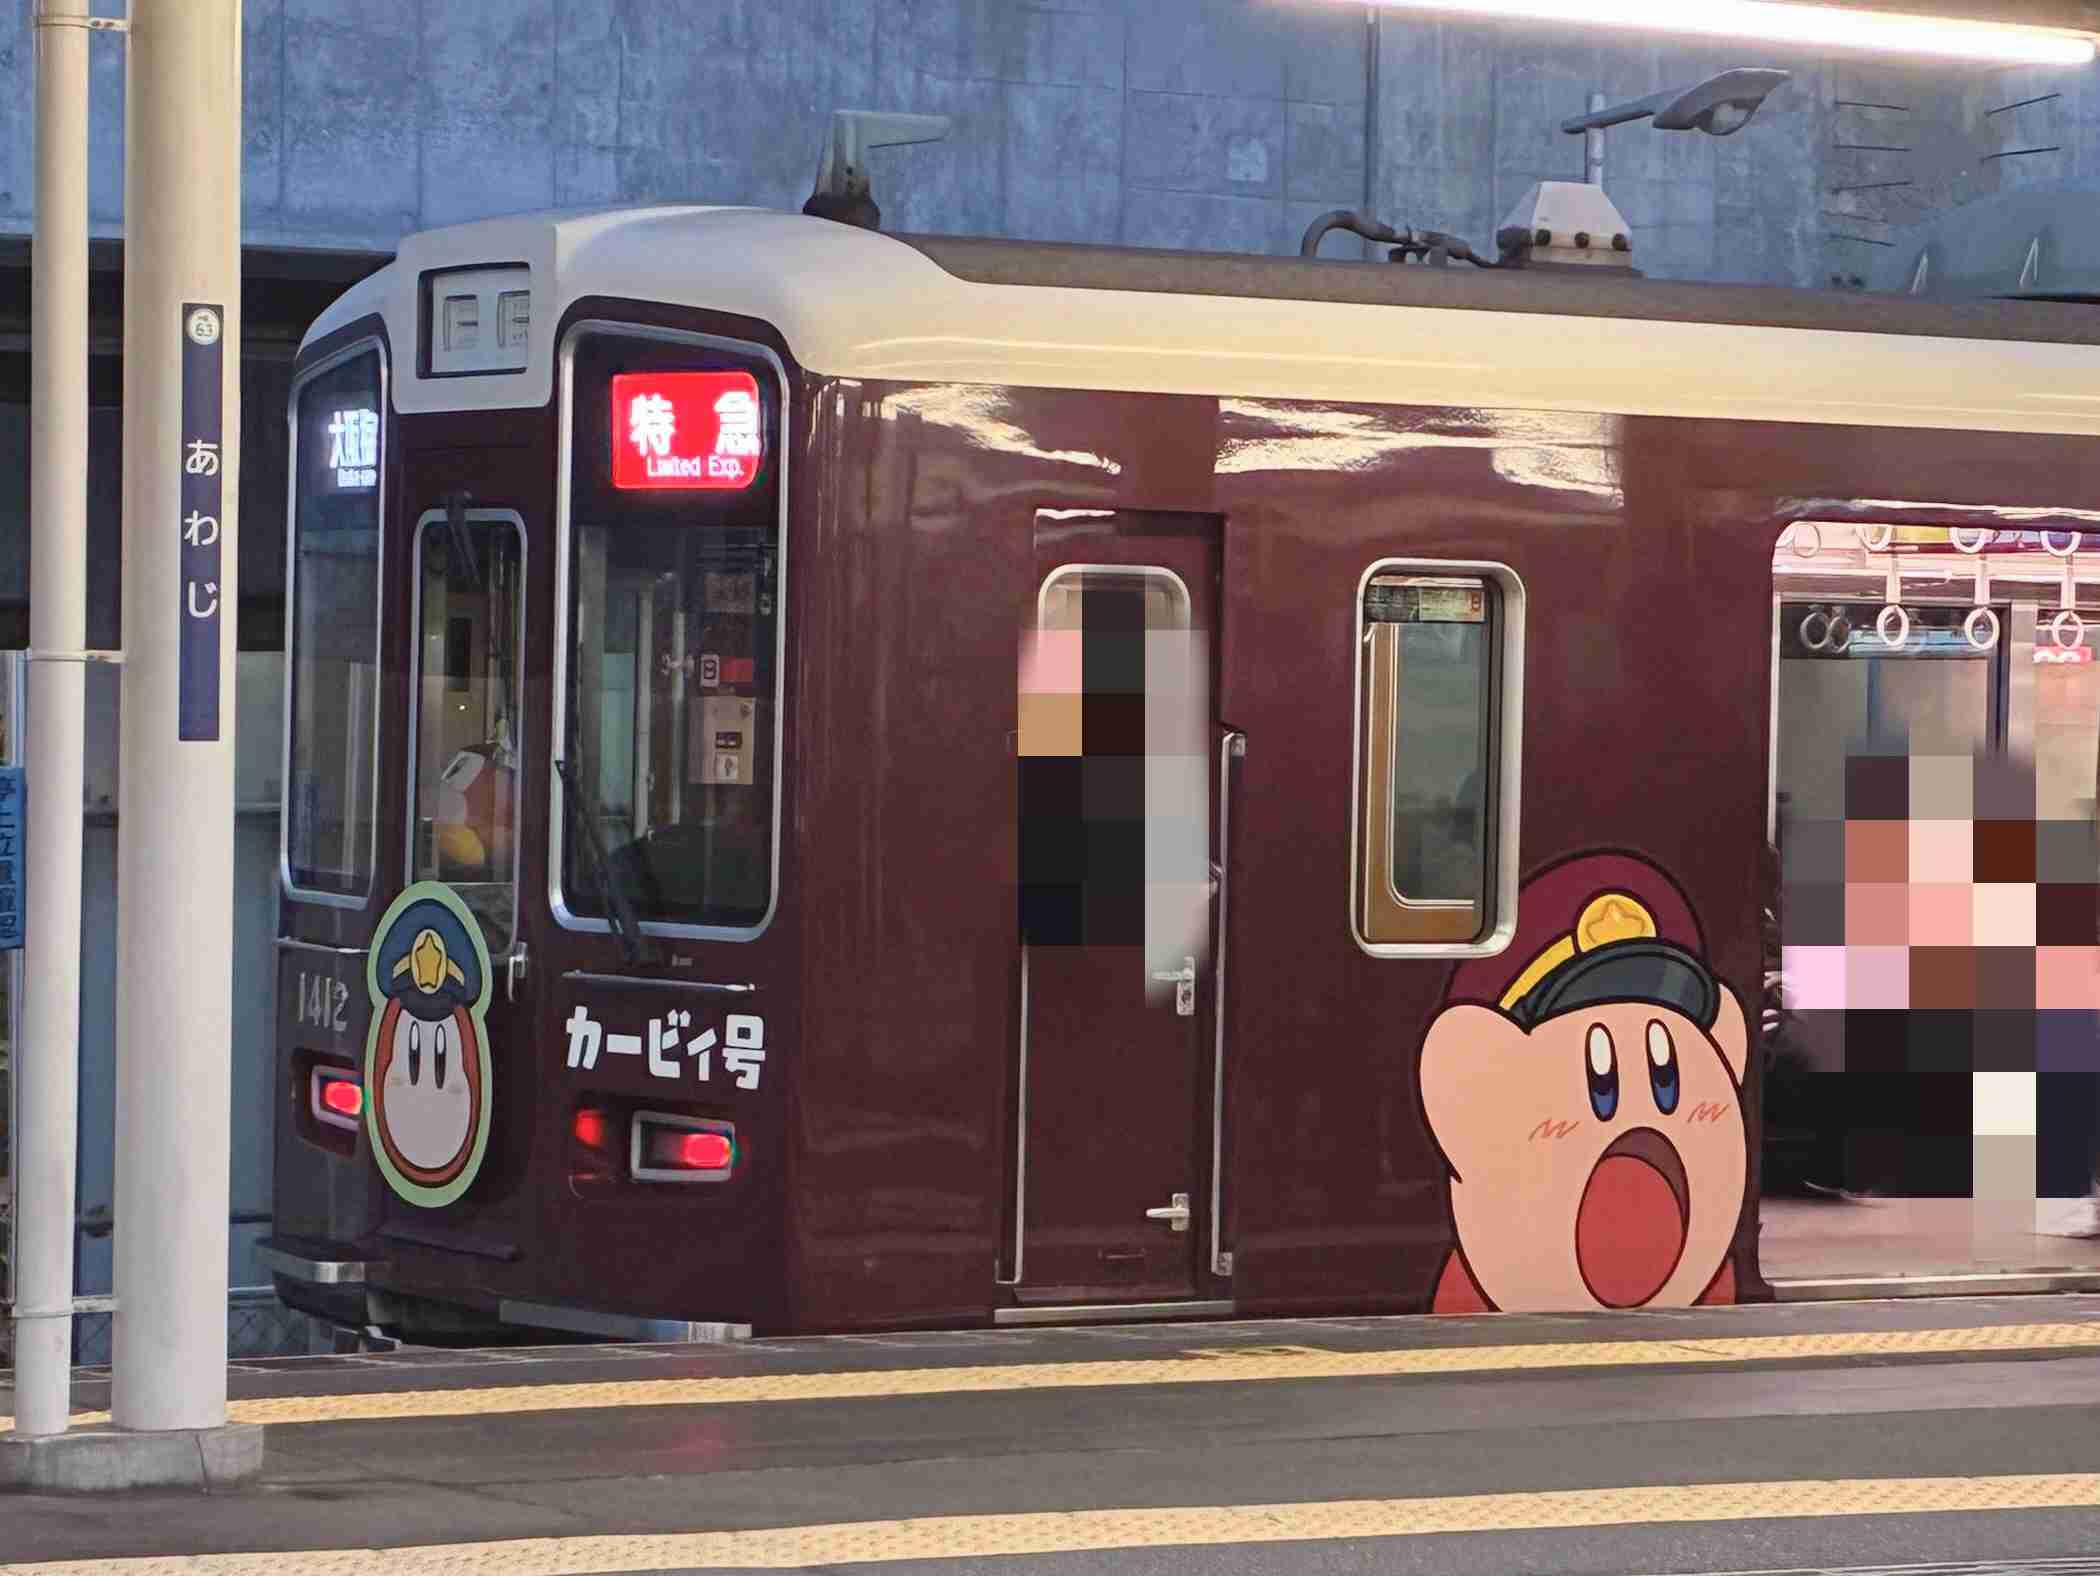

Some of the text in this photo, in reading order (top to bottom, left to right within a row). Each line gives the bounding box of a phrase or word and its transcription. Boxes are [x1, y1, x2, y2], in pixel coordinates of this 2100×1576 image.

[630, 392, 761, 456] 特急
[184, 439, 220, 619] あわじ
[299, 972, 349, 1032] 1412
[566, 1006, 766, 1090] カービィ号
